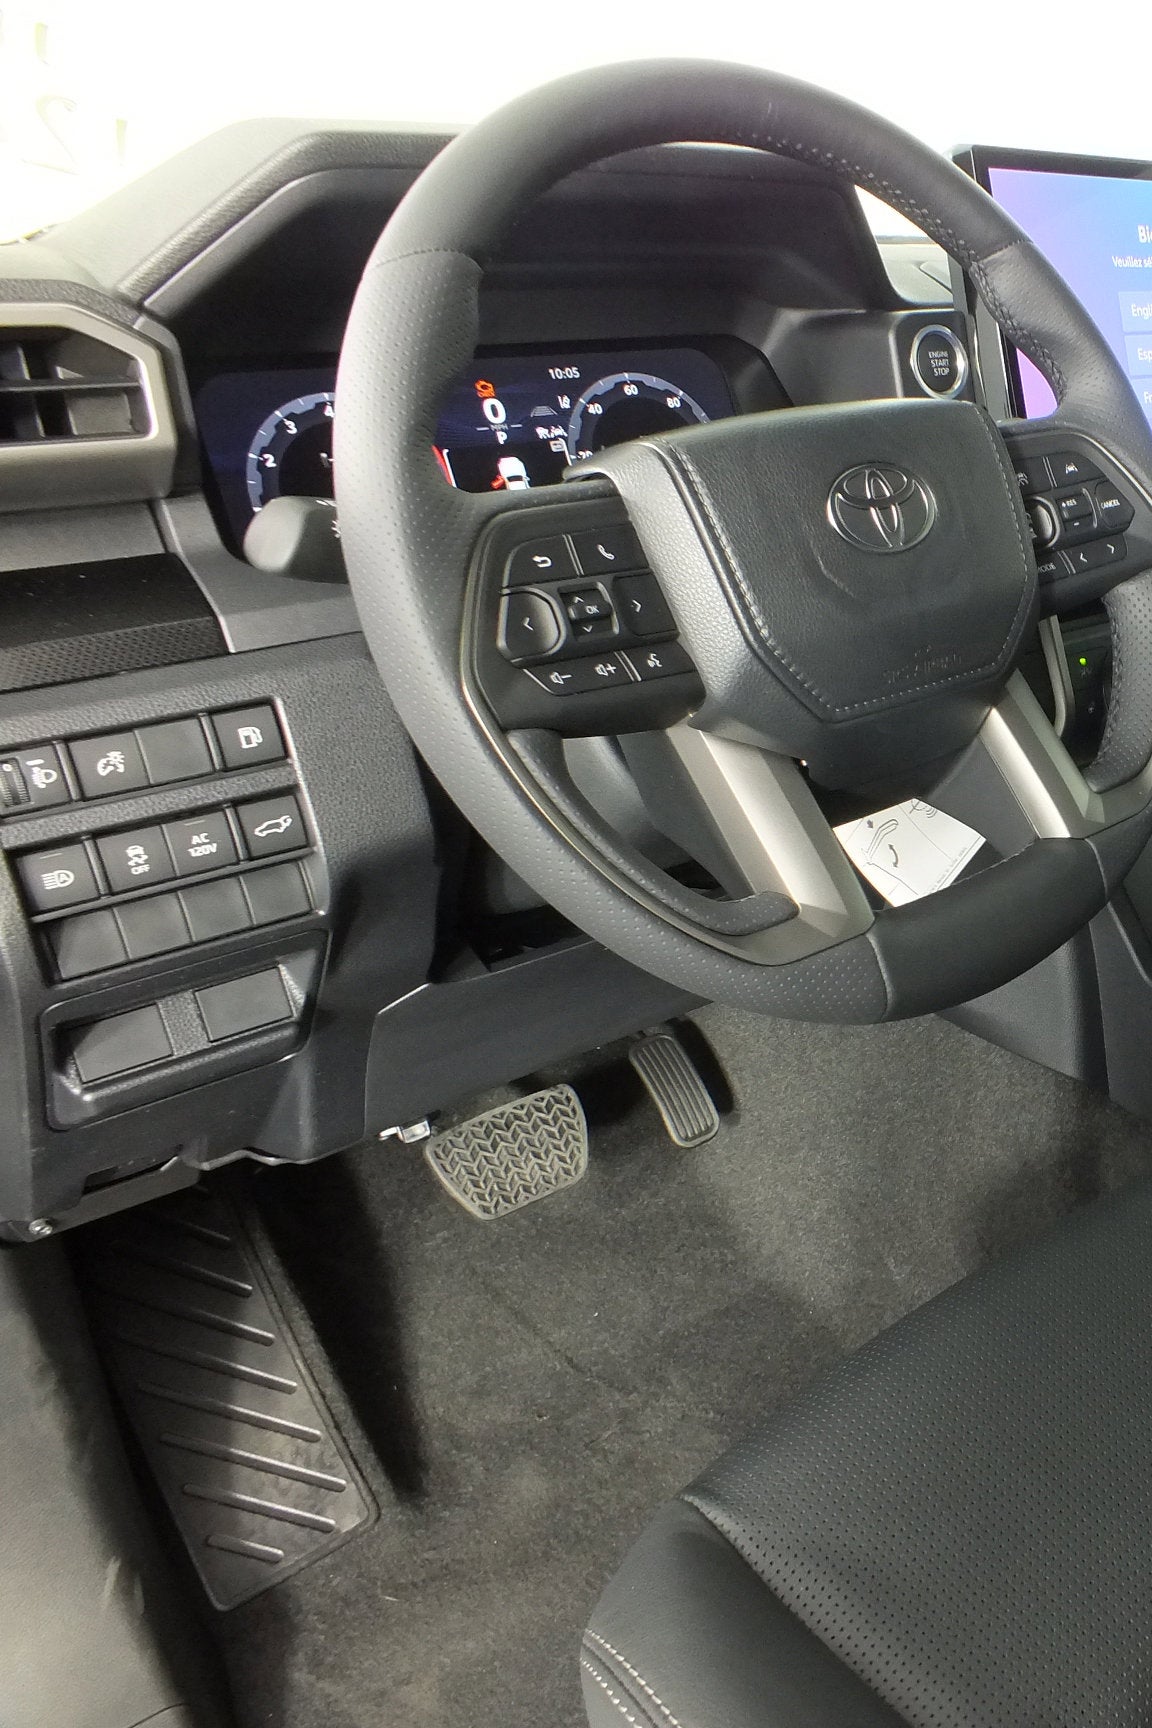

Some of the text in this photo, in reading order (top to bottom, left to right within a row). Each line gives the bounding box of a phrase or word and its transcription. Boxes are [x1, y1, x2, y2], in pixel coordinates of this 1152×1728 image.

[1112, 256, 1143, 268] Veuillez
[548, 366, 580, 380] 10:05
[933, 367, 950, 376] STOP
[623, 384, 639, 396] 60
[587, 402, 603, 414] 40
[666, 397, 681, 408] 80
[483, 398, 506, 424] 0
[284, 420, 298, 434] 3
[496, 431, 508, 445] P
[262, 453, 277, 468] 2
[586, 605, 600, 615] OK
[191, 832, 210, 844] AC
[187, 843, 217, 857] 120V
